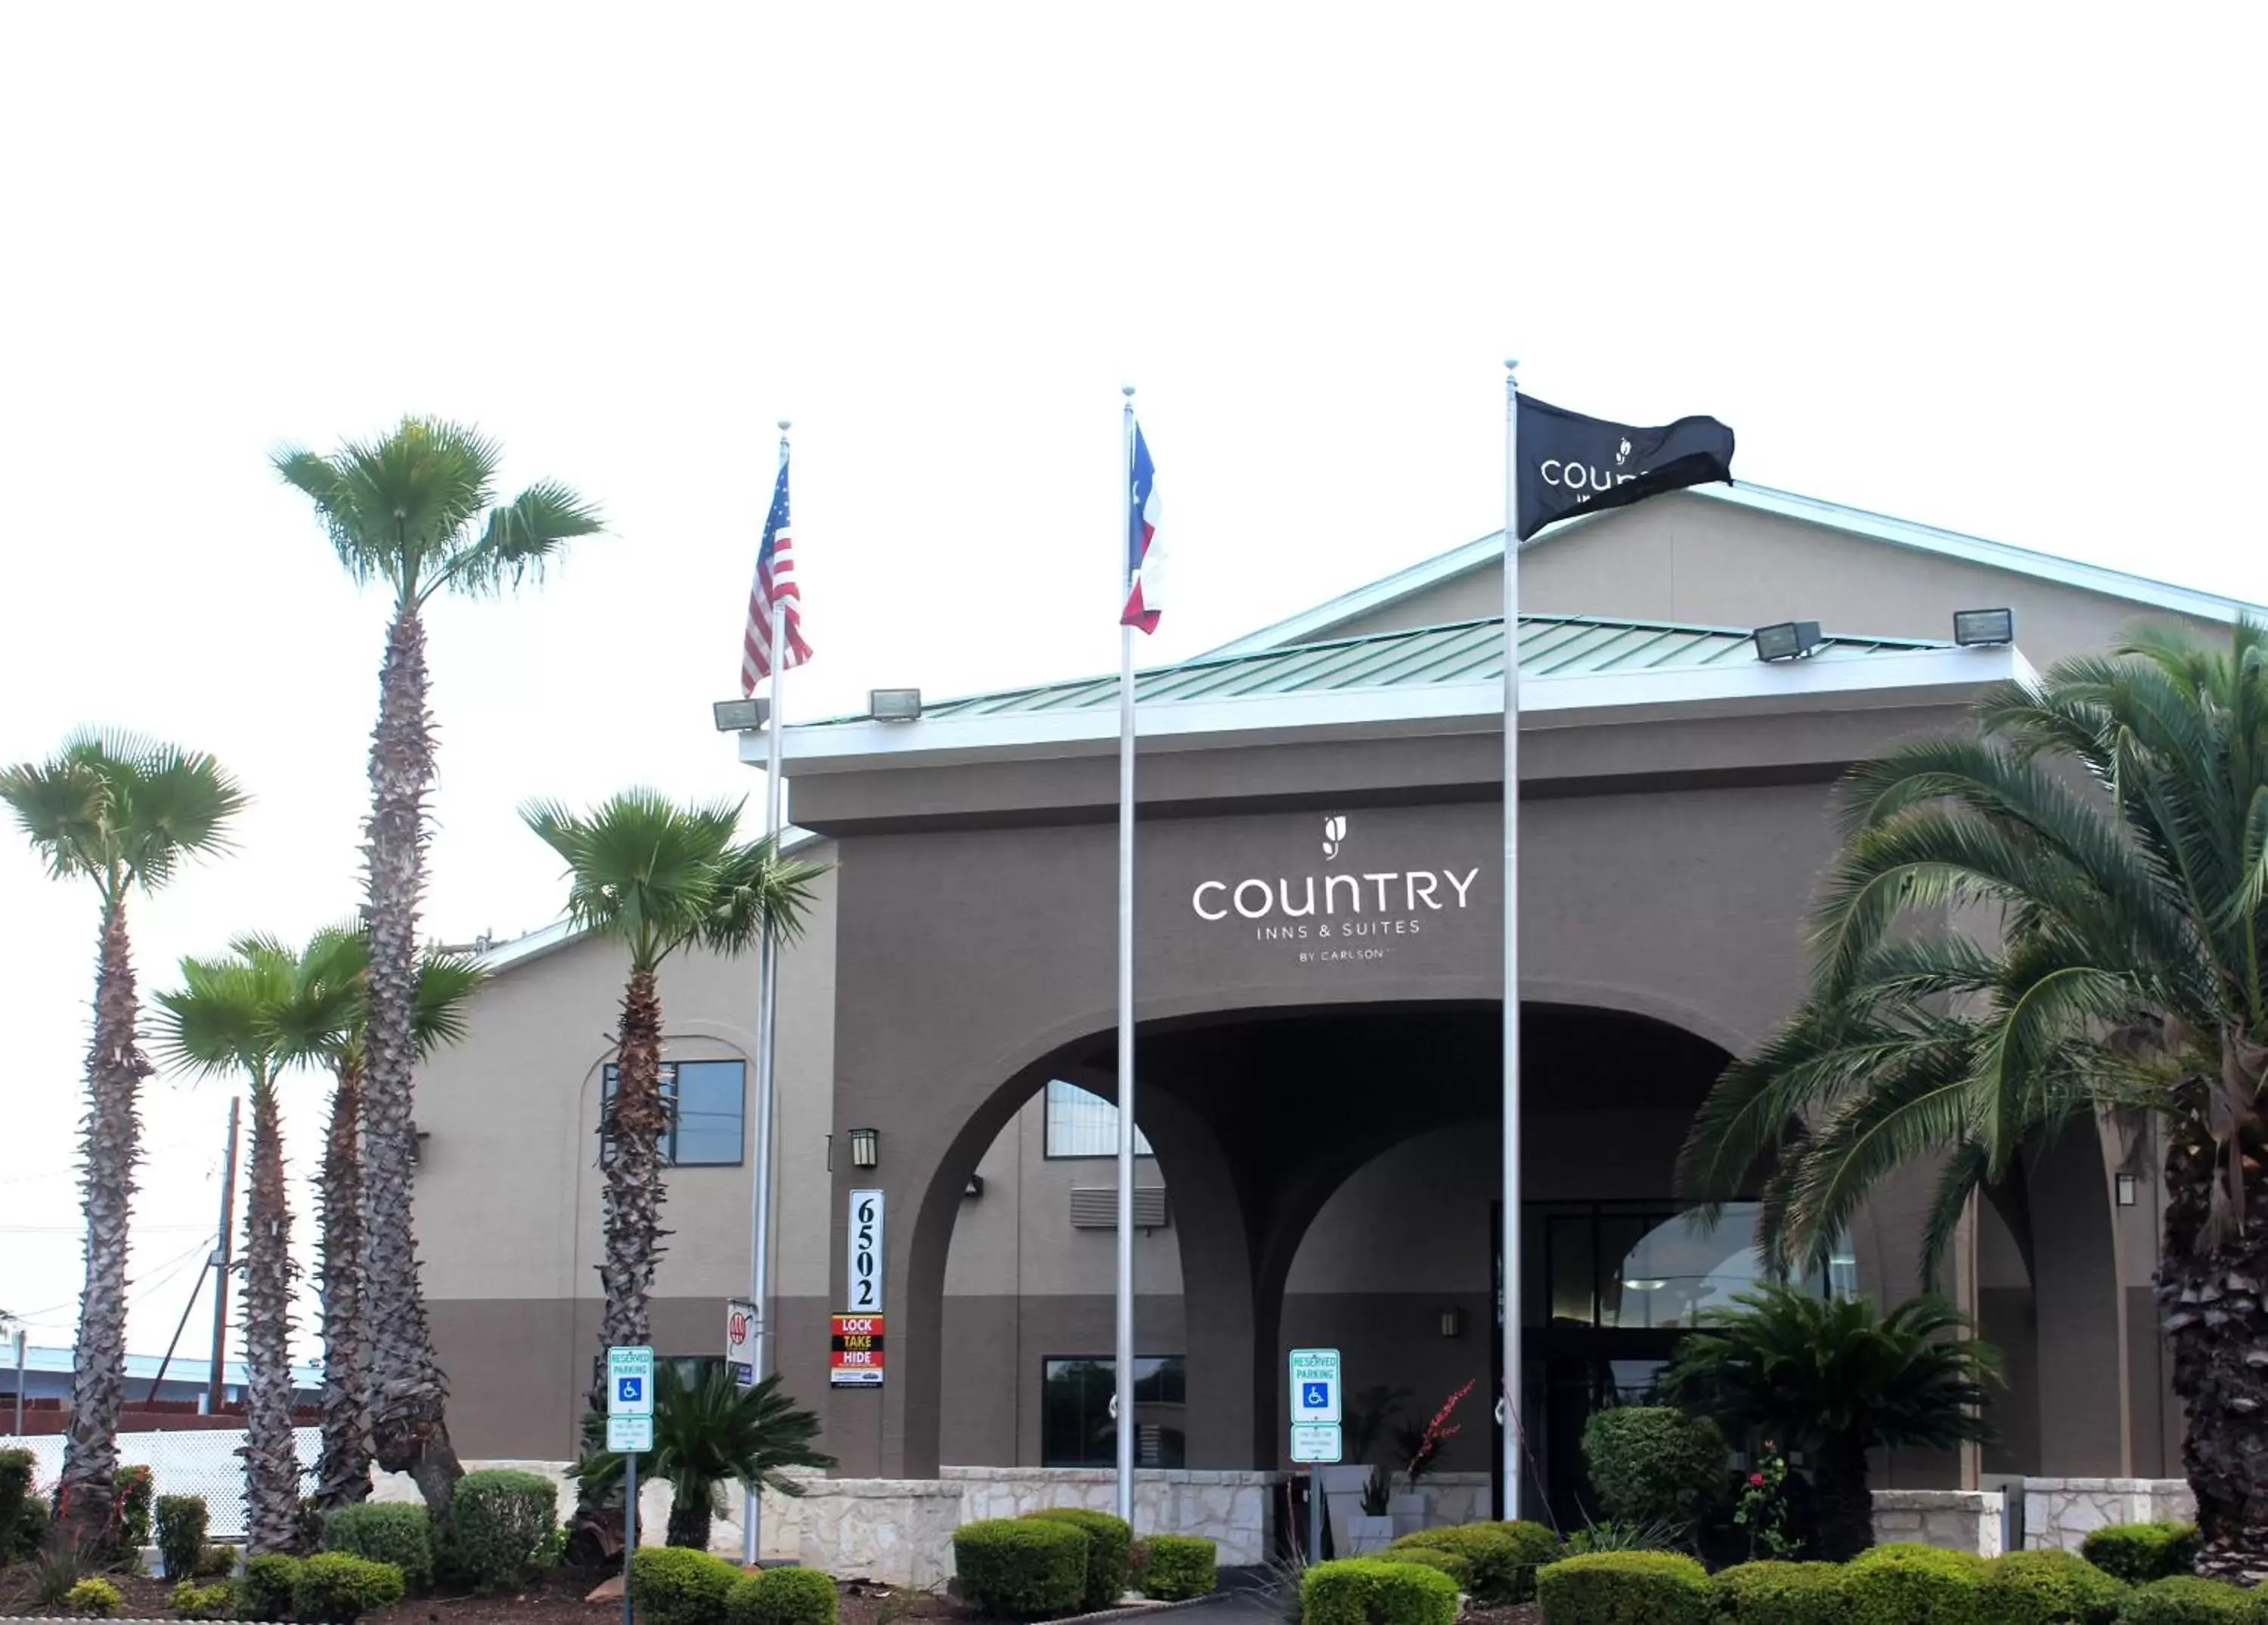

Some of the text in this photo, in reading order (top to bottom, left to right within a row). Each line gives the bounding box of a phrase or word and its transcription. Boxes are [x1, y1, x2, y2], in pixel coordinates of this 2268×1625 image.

[1256, 920, 1420, 940] INNS & SUITES
[1299, 949, 1383, 962] BY CARLSON
[857, 1198, 875, 1305] 6502
[843, 1319, 872, 1331] LOCK
[843, 1336, 872, 1348] TAKE
[612, 1354, 651, 1363] RESERVED
[843, 1351, 872, 1363] HIDE
[1294, 1357, 1336, 1367] RESERVED
[614, 1365, 648, 1375] PARKING
[1297, 1369, 1334, 1379] PARKING
